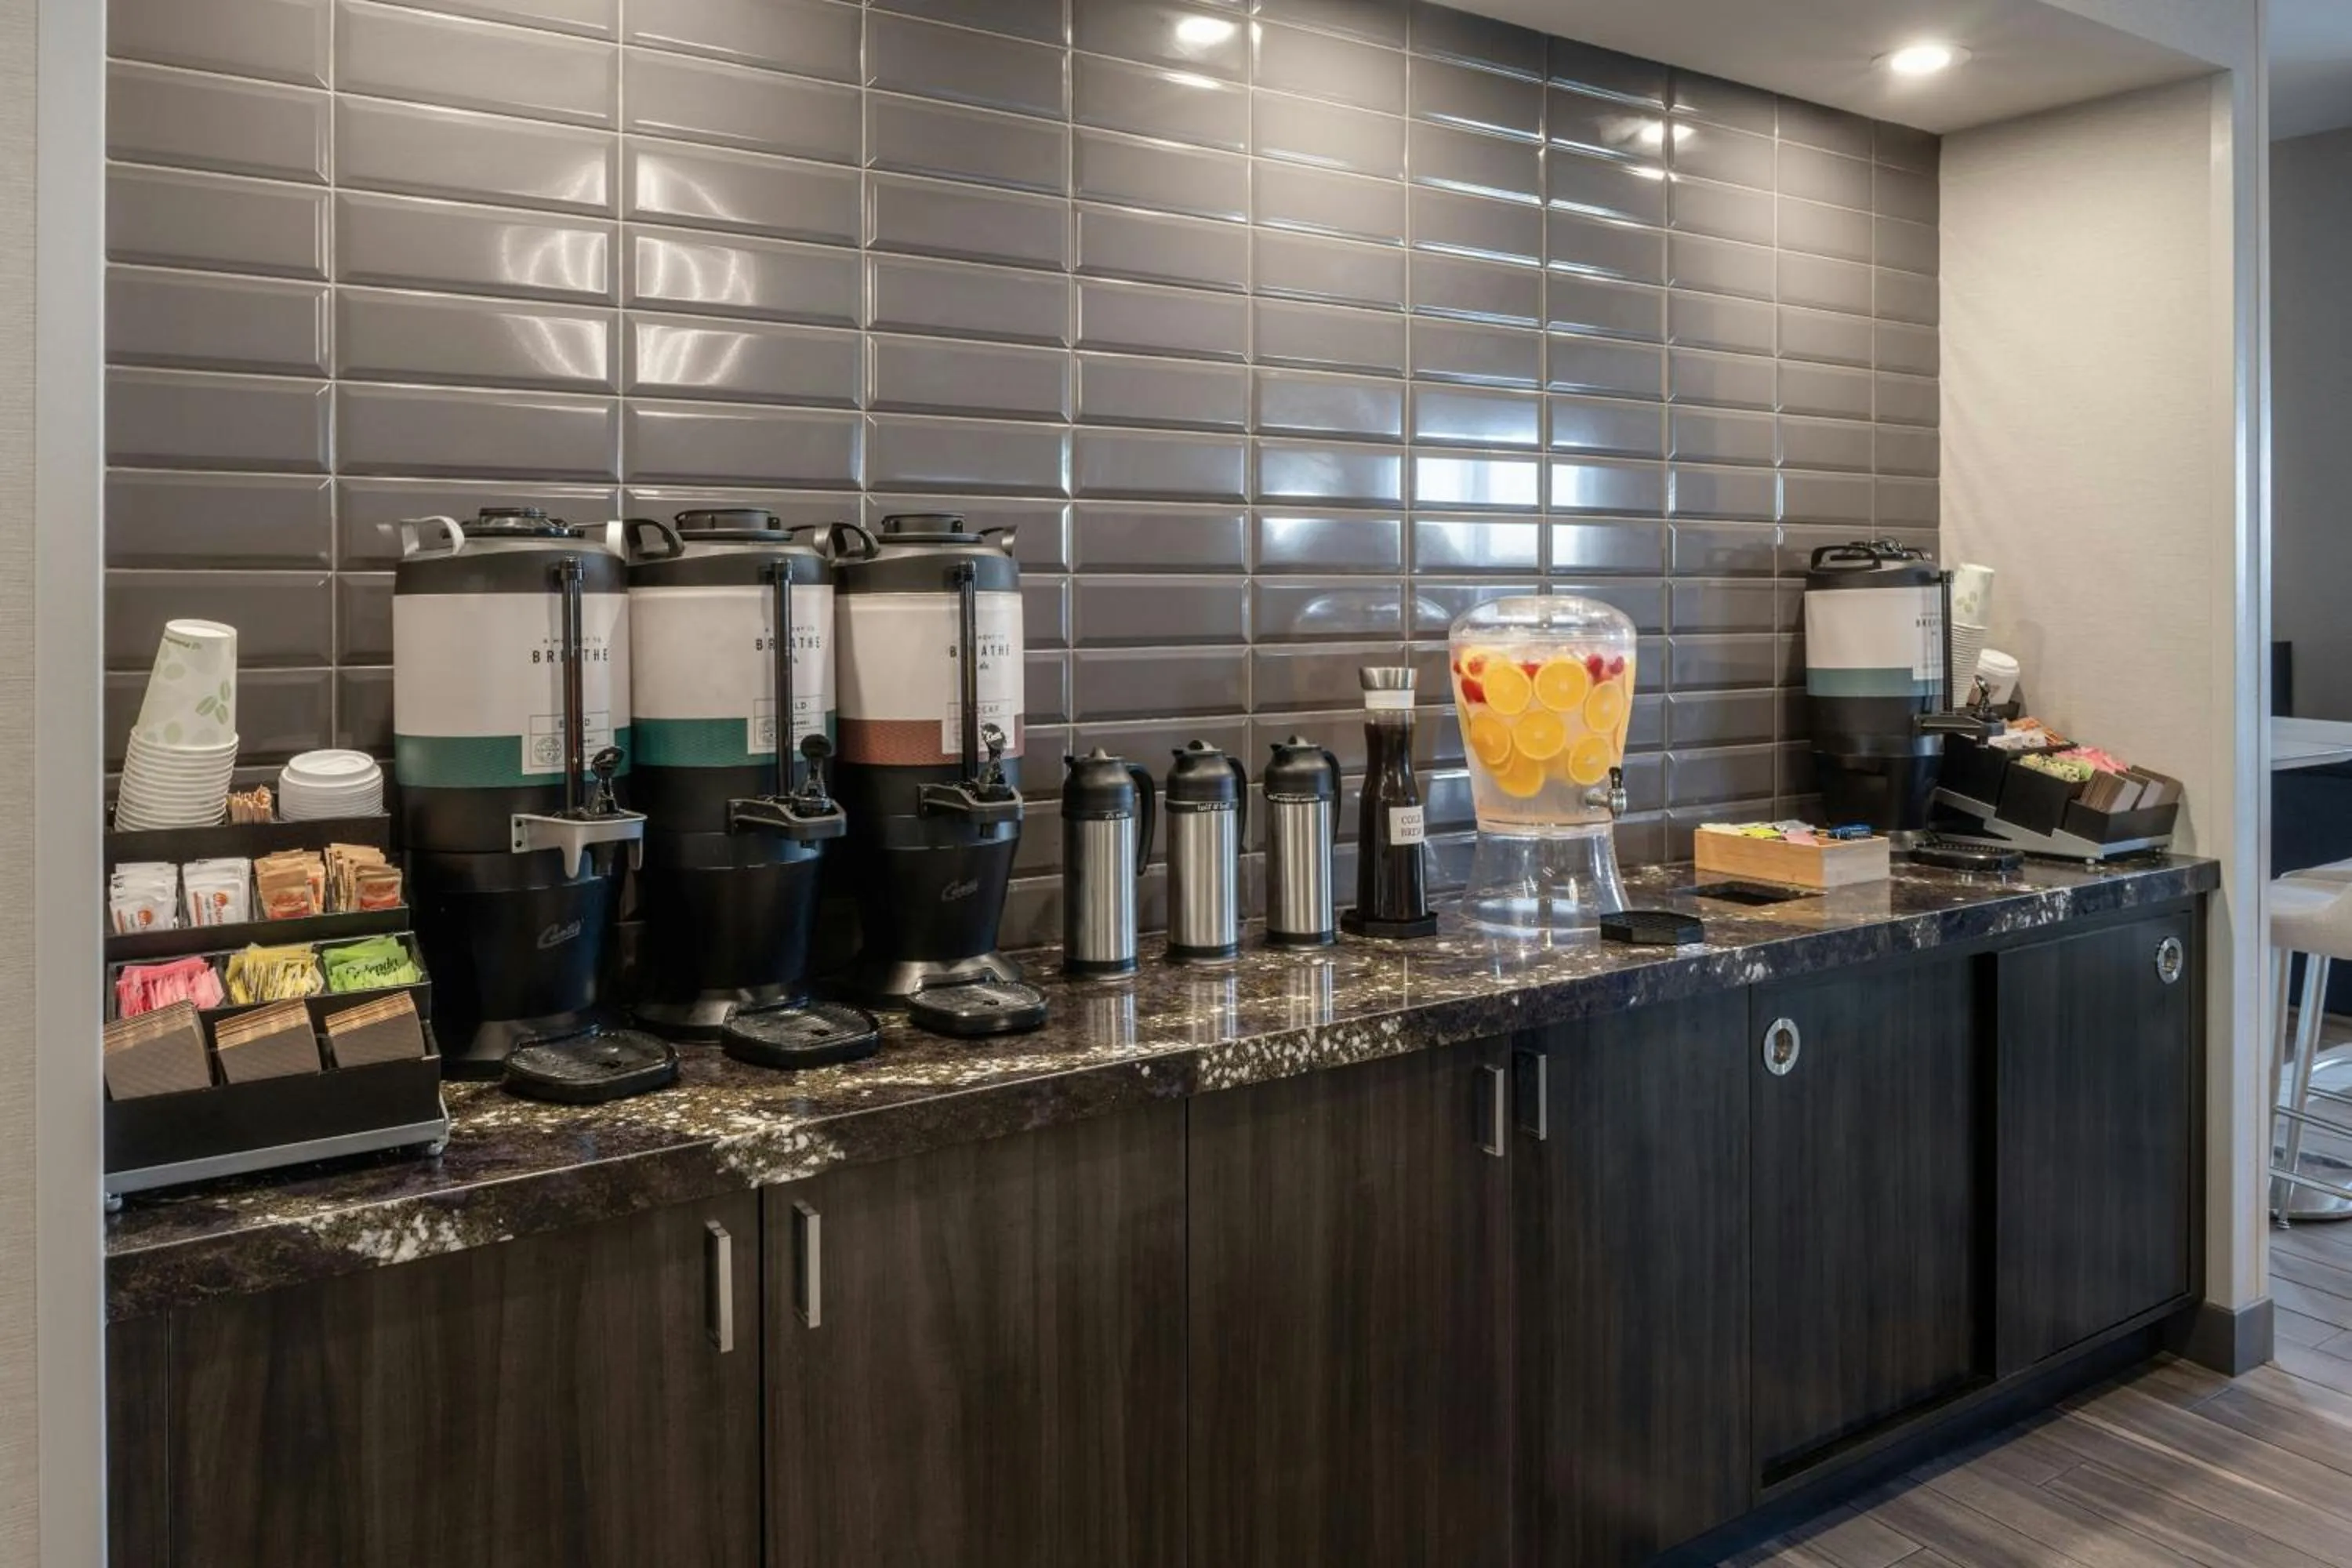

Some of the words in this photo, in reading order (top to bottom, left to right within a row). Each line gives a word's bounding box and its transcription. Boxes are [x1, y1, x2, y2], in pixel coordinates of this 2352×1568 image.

[755, 636, 821, 652] BRATHE
[949, 644, 1010, 659] BATHE
[532, 648, 609, 663] BRETHE
